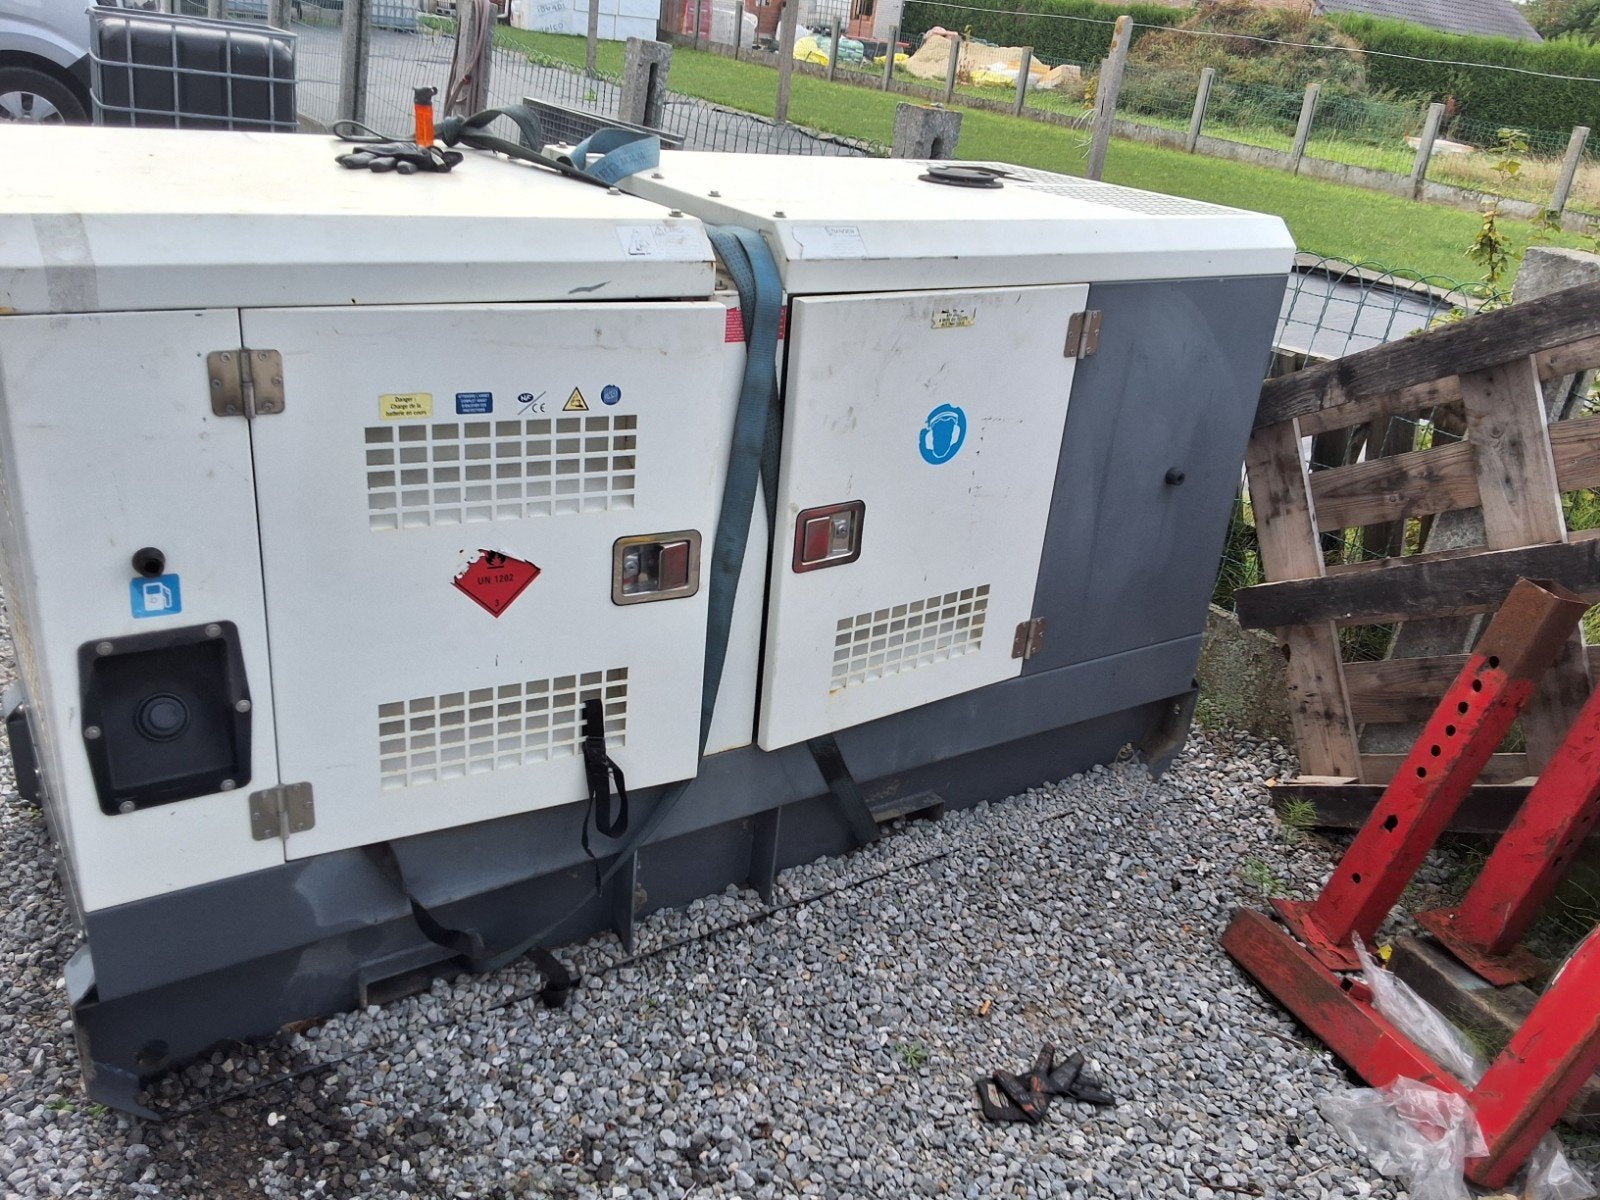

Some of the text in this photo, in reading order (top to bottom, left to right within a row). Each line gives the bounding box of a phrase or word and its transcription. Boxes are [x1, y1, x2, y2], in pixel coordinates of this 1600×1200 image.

[532, 402, 546, 413] CE
[477, 573, 514, 585] UN 1202
